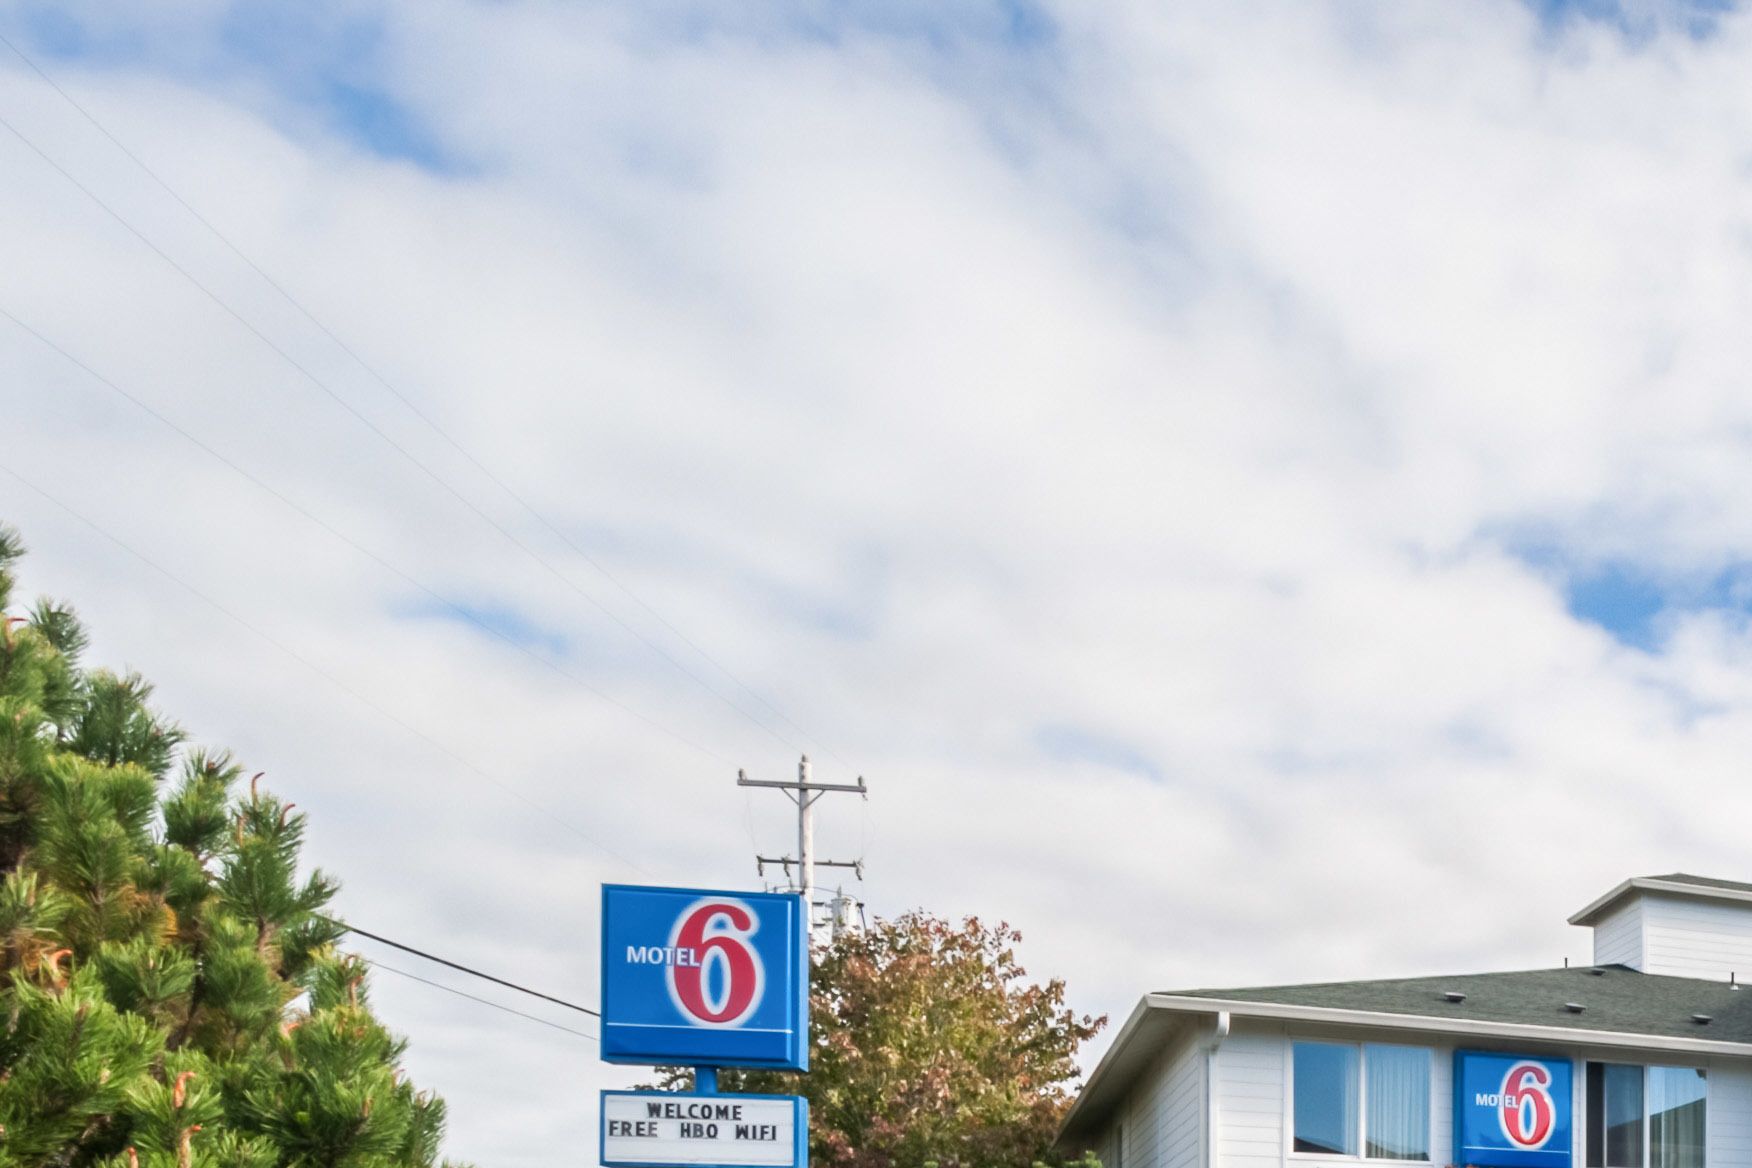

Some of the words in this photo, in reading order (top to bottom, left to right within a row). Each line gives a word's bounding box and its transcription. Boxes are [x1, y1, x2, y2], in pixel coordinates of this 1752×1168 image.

[626, 945, 700, 967] MOTEL
[669, 900, 760, 1026] 6
[608, 1120, 658, 1137] FREE
[680, 1122, 718, 1139] HBO
[735, 1124, 777, 1140] WIFI
[647, 1102, 742, 1120] WELCOME
[1475, 1093, 1518, 1108] MOTEL
[1500, 1062, 1553, 1148] 6
